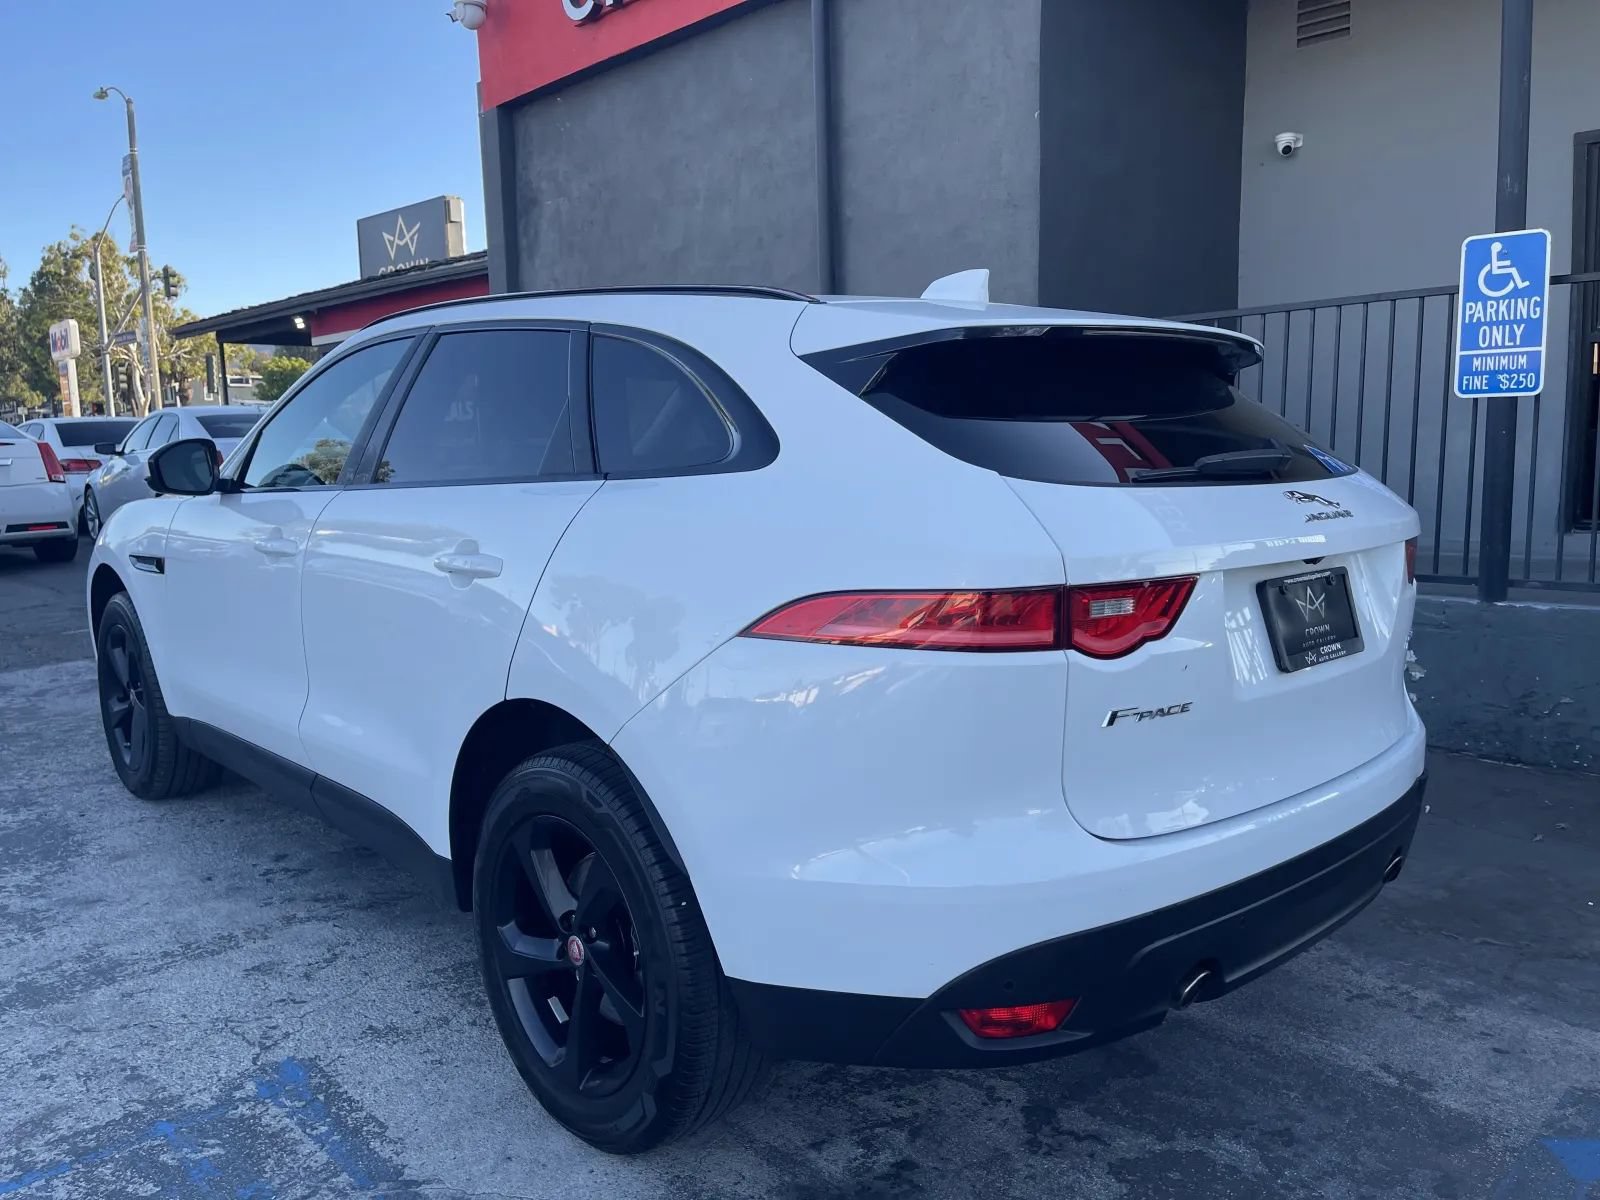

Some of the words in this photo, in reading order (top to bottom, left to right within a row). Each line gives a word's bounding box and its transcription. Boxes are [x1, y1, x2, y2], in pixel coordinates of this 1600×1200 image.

[1465, 296, 1541, 323] PARKING
[51, 328, 69, 353] Mobil
[1478, 324, 1525, 348] ONLY
[1472, 354, 1527, 372] MINIMUM
[1462, 374, 1489, 391] FINE
[1499, 372, 1536, 391] $250
[1304, 509, 1354, 523] JAGUAR
[1305, 624, 1330, 636] CROWN
[1320, 642, 1341, 654] CROWN
